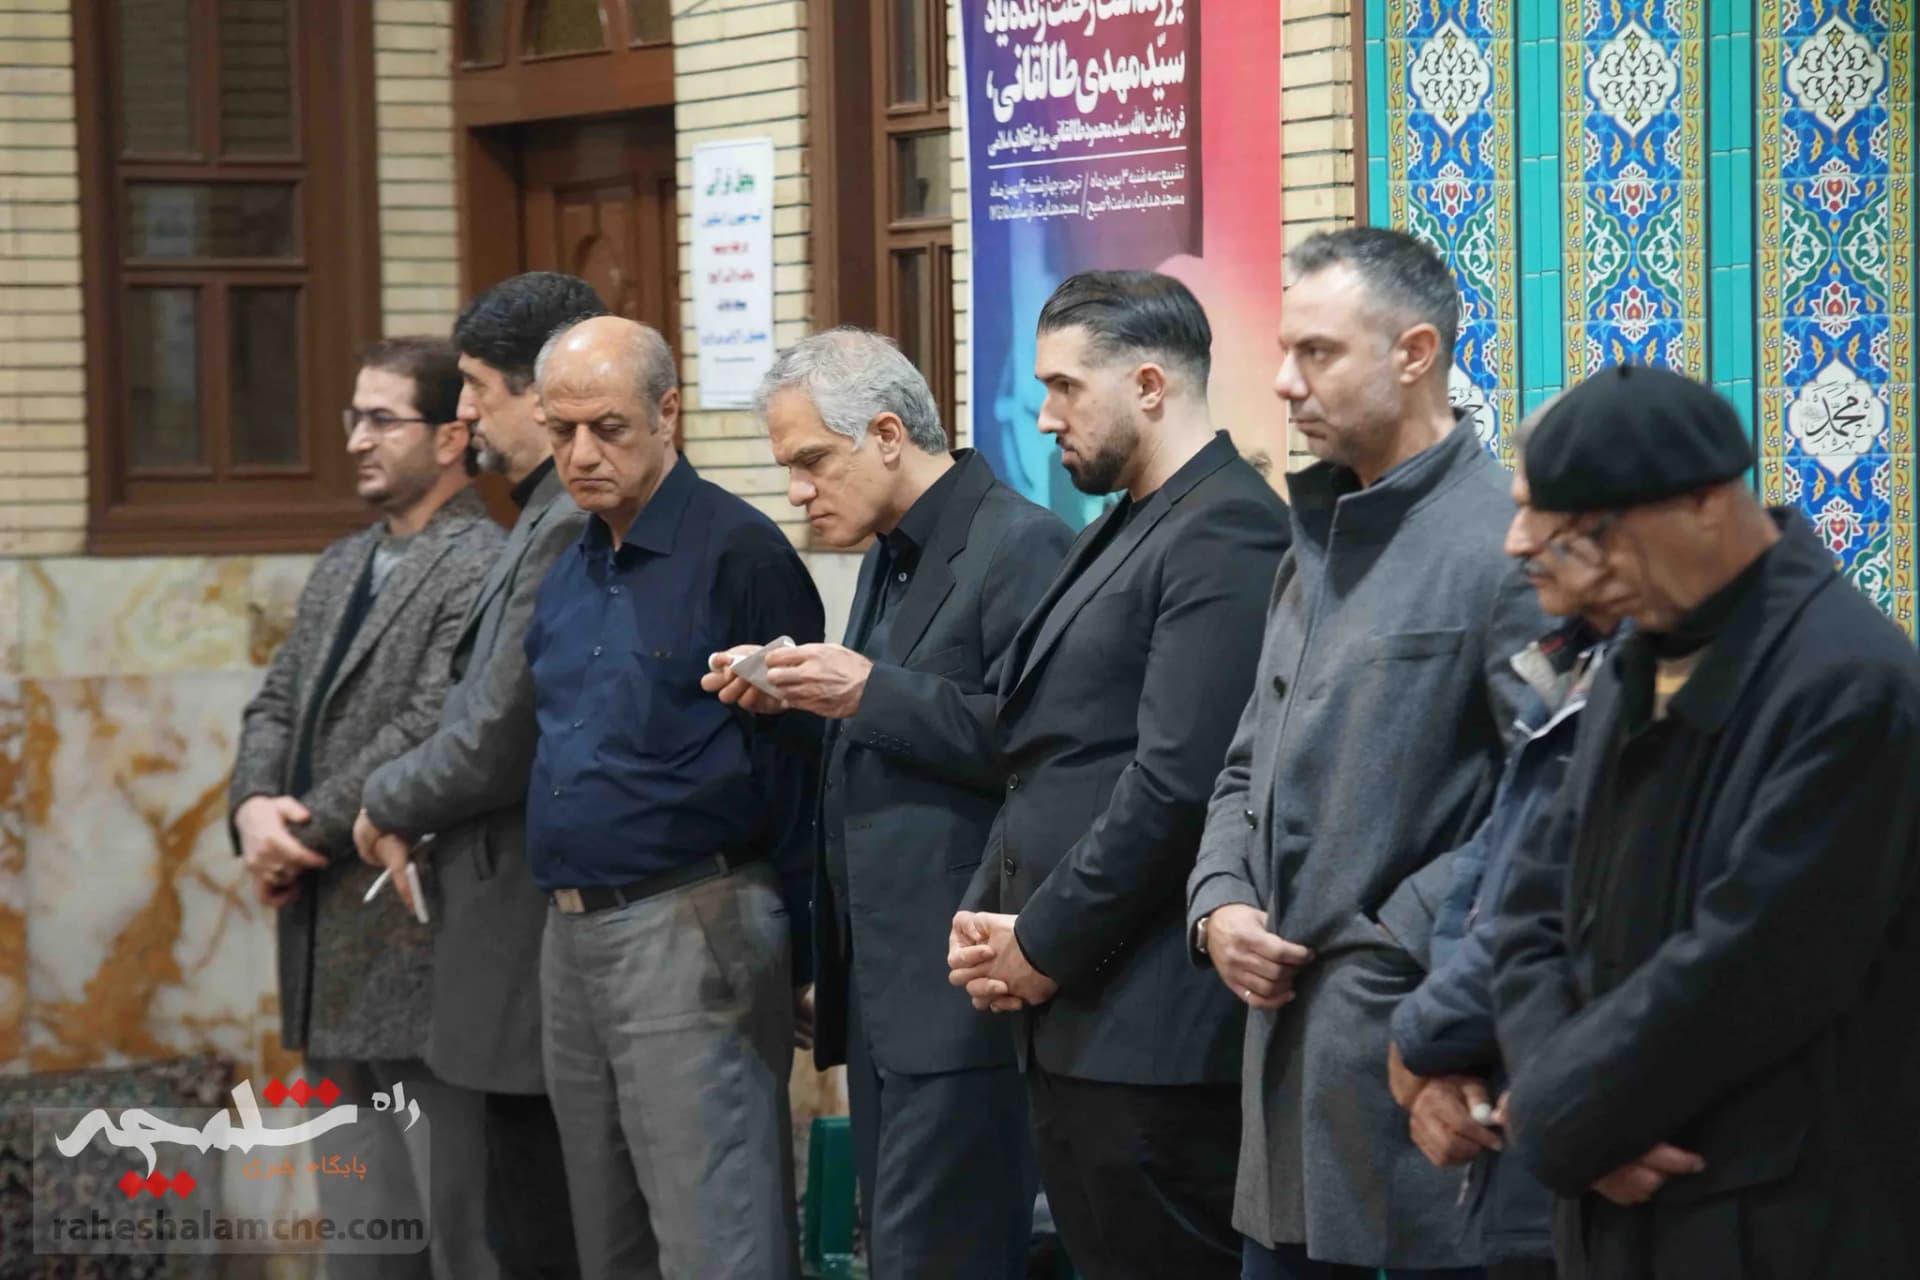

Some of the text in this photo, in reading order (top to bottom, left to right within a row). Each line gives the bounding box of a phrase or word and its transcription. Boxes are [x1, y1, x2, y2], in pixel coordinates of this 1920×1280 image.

[1075, 48, 1140, 114] مهدی
[1162, 105, 1186, 139] فرزند
[1161, 194, 1185, 211] مسجد
